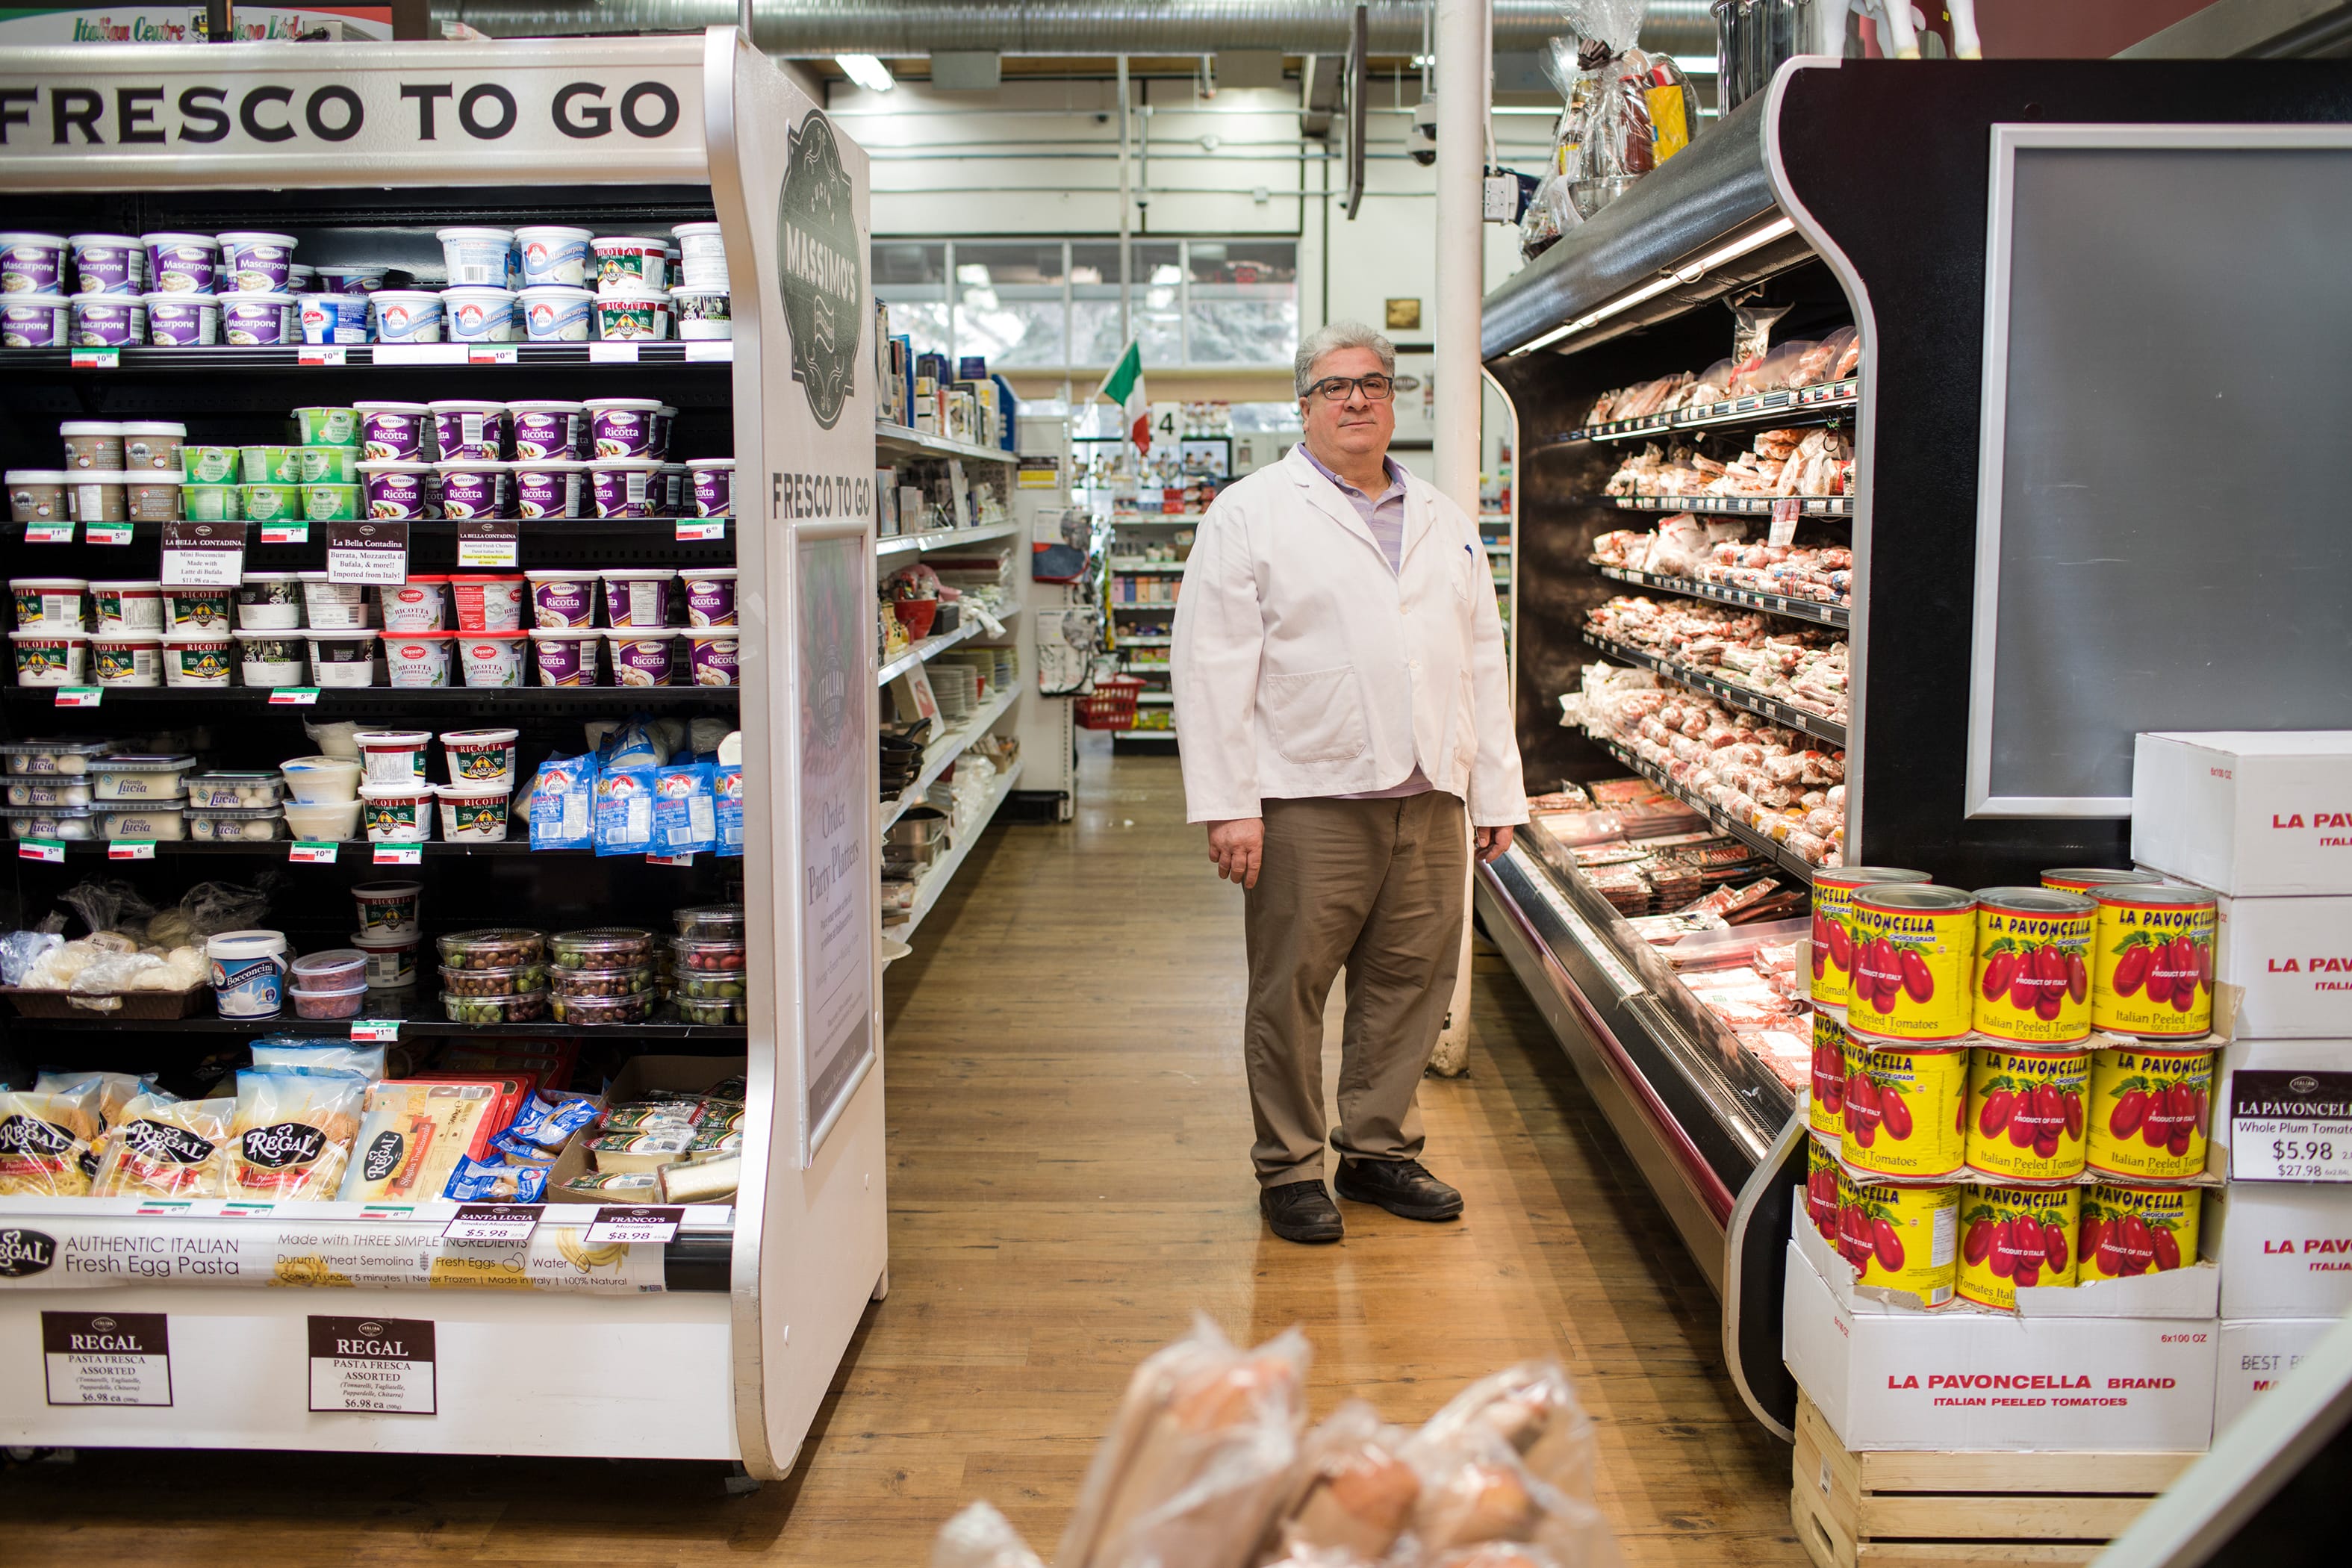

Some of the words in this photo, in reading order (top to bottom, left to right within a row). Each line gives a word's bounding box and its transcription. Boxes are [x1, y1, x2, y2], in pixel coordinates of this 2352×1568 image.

[72, 16, 129, 41] Italian
[133, 16, 185, 41] Centre
[234, 16, 264, 40] hop
[266, 15, 302, 40] Ltd.
[0, 84, 364, 145] FRESCO
[400, 81, 518, 140] TO
[551, 81, 680, 139] GO
[164, 260, 212, 272] Mascarpone
[786, 221, 856, 306] MASSIMO'S
[606, 302, 648, 311] RICOTTA
[1159, 412, 1174, 435] 4
[523, 430, 554, 439] Ricotta
[384, 490, 417, 499] Ricotta
[449, 489, 482, 498] Ricotta
[773, 473, 831, 520] FRESCO
[836, 476, 852, 518] TO
[856, 478, 870, 517] GO
[364, 540, 402, 548] Contadina
[269, 596, 293, 605] salut
[546, 598, 580, 606] Ricotta
[691, 597, 721, 605] Ricotta
[632, 656, 665, 665] Ricotta
[117, 780, 146, 794] Lucia
[822, 794, 845, 839] Order
[808, 864, 830, 906] Party
[832, 839, 859, 883] Platters
[1855, 909, 1935, 932] PAVONCELLA
[1988, 914, 2003, 930] LA
[2009, 919, 2091, 936] PAVONCELLA
[226, 964, 273, 986] Bocconcini
[2116, 1009, 2149, 1024] Italian
[2153, 1012, 2185, 1024] Peeled
[1986, 1054, 2001, 1068] LA
[2007, 1057, 2088, 1076] PAVONCELLA
[2239, 1101, 2259, 1114] LA
[2239, 1121, 2276, 1133] Whole
[2280, 1122, 2308, 1133] Plum
[0, 1124, 66, 1150] REGAL
[130, 1123, 204, 1160] REGAL
[246, 1132, 315, 1160] REGAL
[2273, 1139, 2333, 1161] $5.98
[367, 1134, 399, 1180] REGAL
[400, 1160, 417, 1186] Sfoglia
[411, 1124, 431, 1163] Tradizionale
[2112, 1151, 2144, 1168] Italian
[2148, 1157, 2180, 1169] Peeled
[2278, 1165, 2321, 1177] $27.98
[1984, 1186, 2068, 1208] PAVONCELLA
[2095, 1188, 2183, 1209] PAVONCELLA
[465, 1228, 508, 1237] $5.98
[607, 1231, 650, 1240] $8.98
[65, 1235, 164, 1254] AUTHENTIC
[171, 1236, 240, 1255] ITALIAN
[278, 1233, 317, 1245] Made
[322, 1234, 349, 1246] with
[353, 1235, 391, 1246] THREE
[394, 1235, 439, 1247] SIMPLE
[66, 1254, 121, 1273] Fresh
[128, 1256, 172, 1278] Egg
[178, 1256, 240, 1275] Pasta
[277, 1254, 315, 1265] Durum
[320, 1254, 357, 1265] Wheat
[361, 1255, 414, 1266] Semolina
[436, 1257, 464, 1267] Fresh
[468, 1257, 496, 1270] Eggs
[532, 1258, 567, 1269] Water
[324, 1273, 352, 1282] under
[363, 1275, 400, 1283] minutes
[413, 1275, 440, 1284] Never
[488, 1276, 518, 1285] Made
[520, 1276, 529, 1285] in
[531, 1276, 551, 1286] Italy
[564, 1277, 588, 1285] 100%
[591, 1278, 627, 1286] Natural
[1959, 1275, 1994, 1296] Tomates
[70, 1334, 143, 1351] REGAL
[2160, 1334, 2190, 1343] 6x100
[2191, 1334, 2207, 1343] OZ
[336, 1339, 408, 1356] REGAL
[69, 1355, 102, 1363] PASTA
[105, 1355, 146, 1364] FRESCA
[334, 1360, 367, 1369] PASTA
[370, 1361, 411, 1370] FRESCA
[2241, 1354, 2280, 1371] BEST
[345, 1372, 400, 1381] ASSORTED
[1888, 1375, 1920, 1390] LA
[1927, 1375, 2091, 1390] PAVONCELLA
[2107, 1377, 2177, 1390] BRAND
[345, 1399, 371, 1408] $6.98
[1933, 1397, 1987, 1407] ITALIAN
[1991, 1397, 2047, 1407] PEELED
[2050, 1397, 2128, 1407] TOMATOES
